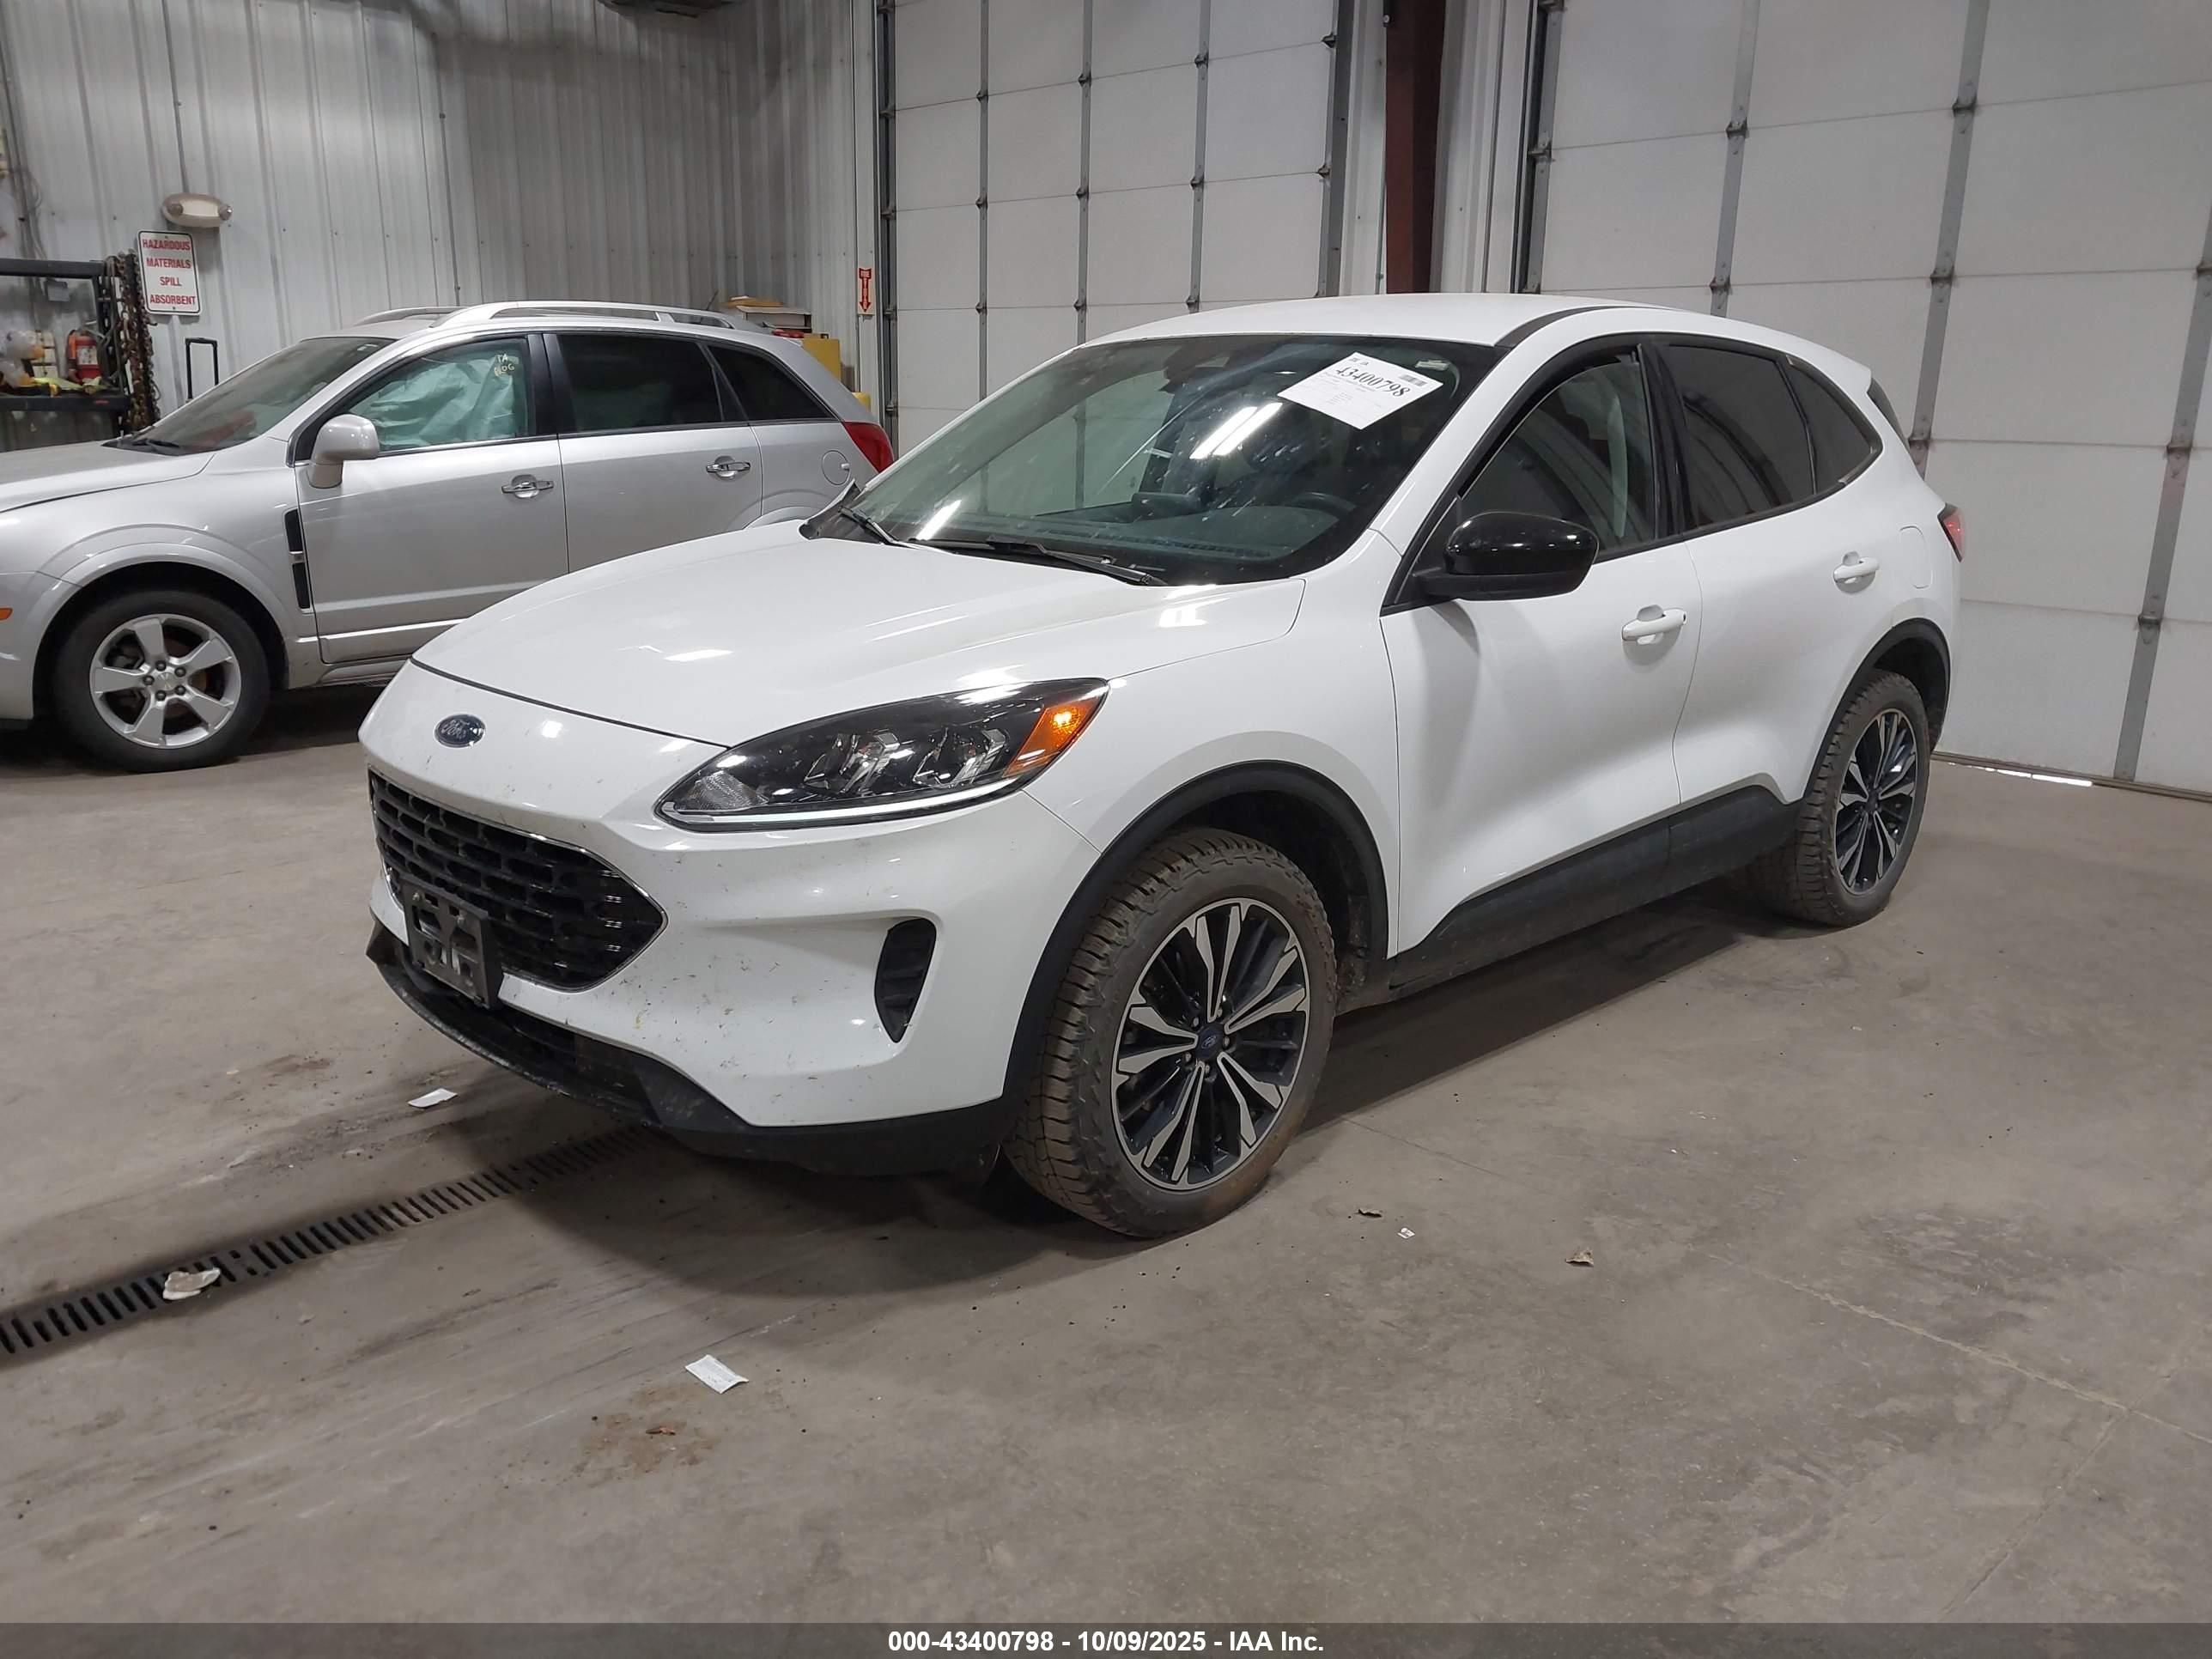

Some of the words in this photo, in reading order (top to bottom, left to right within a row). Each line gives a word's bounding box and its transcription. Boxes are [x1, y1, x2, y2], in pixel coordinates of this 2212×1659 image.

[142, 239, 191, 251] HAZARDOUS
[146, 257, 191, 269] MATERIALS
[160, 276, 182, 287] SPILL
[149, 294, 196, 305] ABSORBENT
[1335, 366, 1411, 397] 43400798
